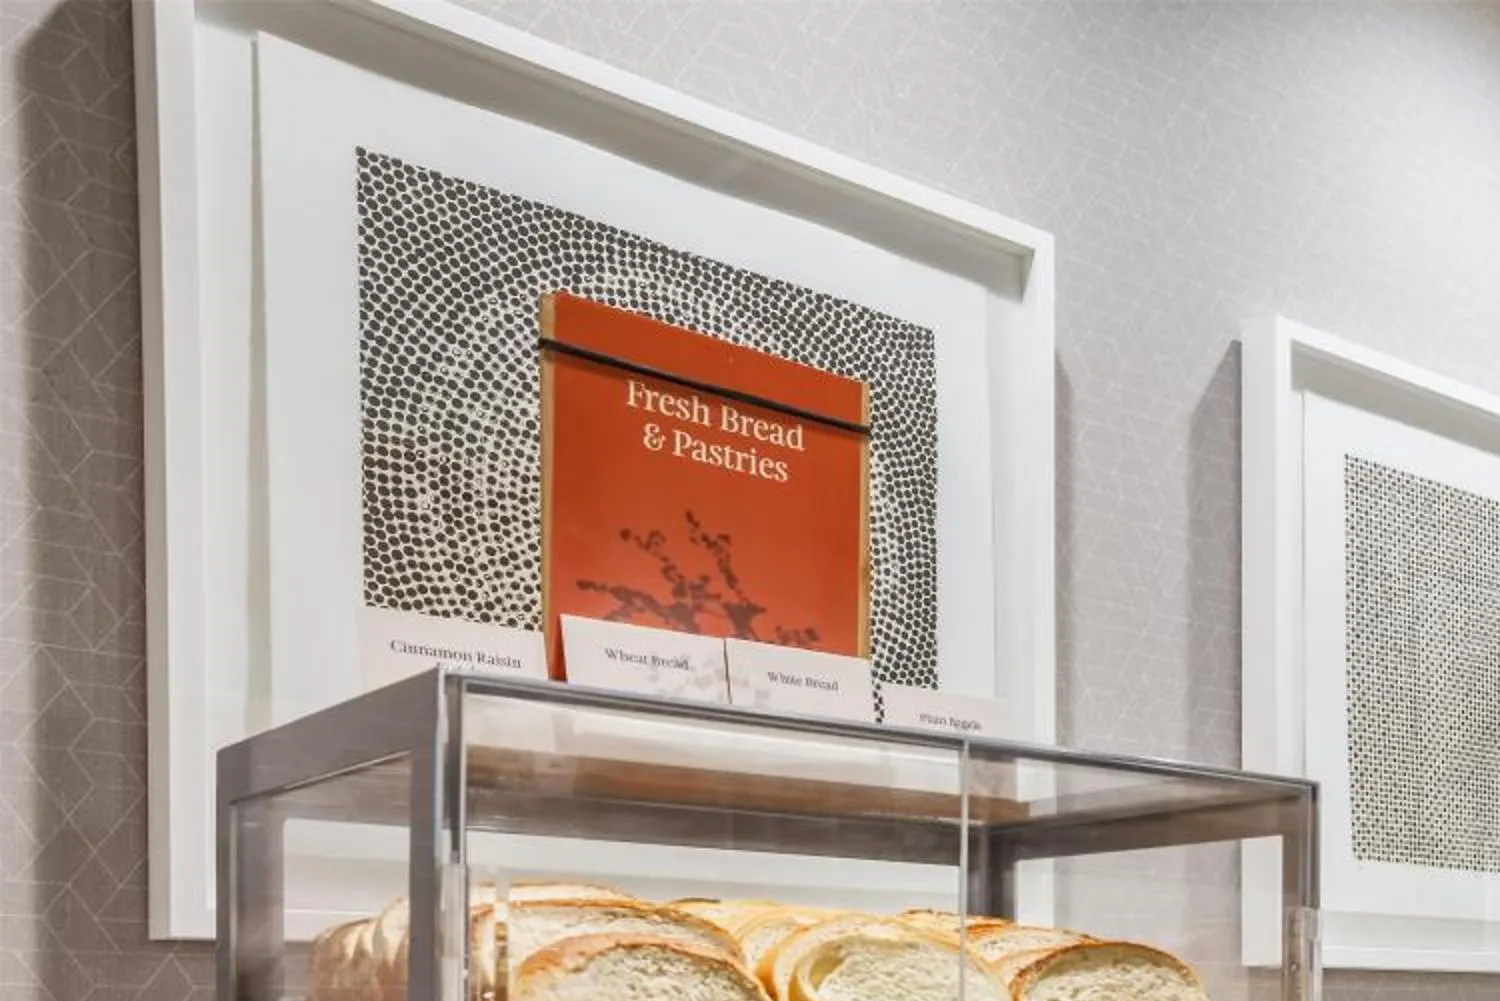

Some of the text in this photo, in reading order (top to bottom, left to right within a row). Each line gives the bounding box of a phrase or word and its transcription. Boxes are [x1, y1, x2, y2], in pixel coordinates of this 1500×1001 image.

[626, 379, 805, 451] Fresh Bread
[643, 423, 788, 483] & Pastries
[390, 639, 473, 662] Cinnamon
[477, 651, 521, 669] Raisin
[604, 648, 689, 670] Wheat Bread
[767, 671, 839, 691] White Bread
